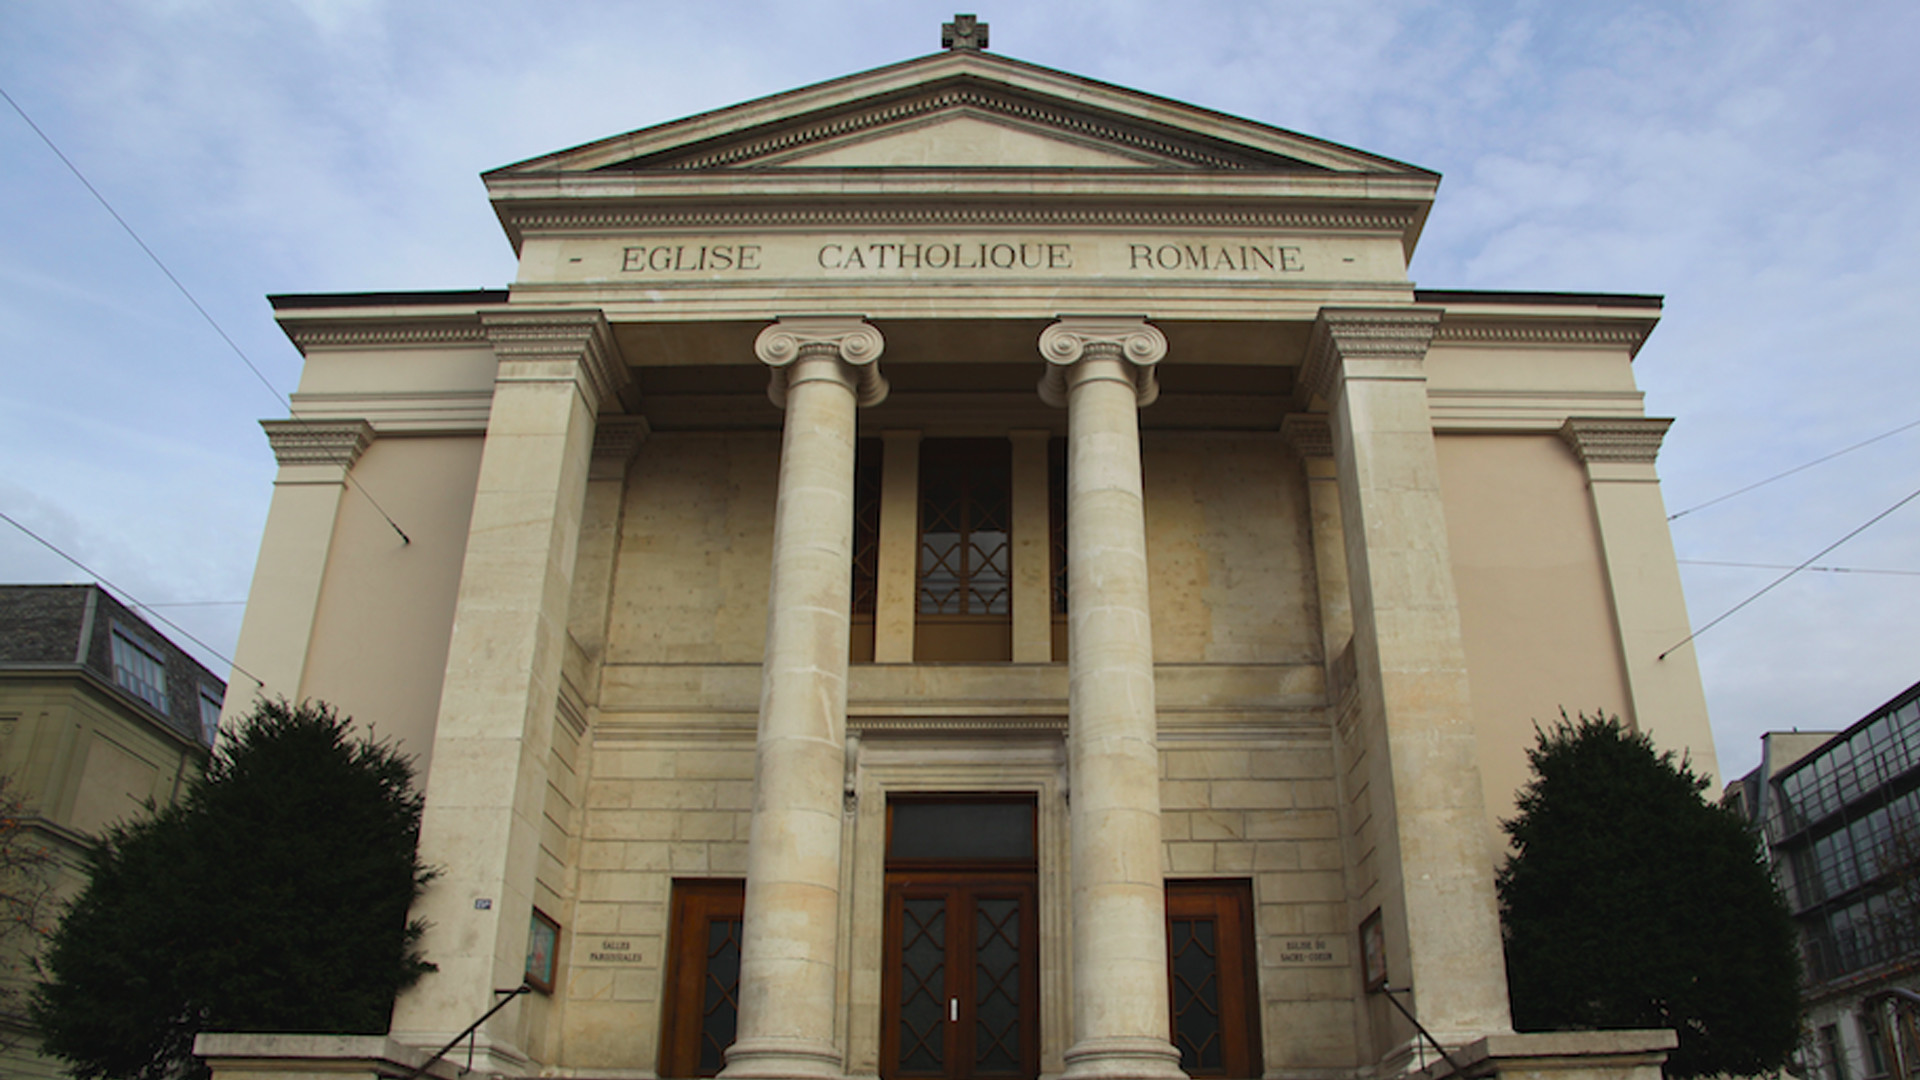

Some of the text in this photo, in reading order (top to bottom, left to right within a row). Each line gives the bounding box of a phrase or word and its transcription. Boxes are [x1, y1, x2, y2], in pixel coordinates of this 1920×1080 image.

[620, 243, 1306, 273] EGLISE CATHOLIQUE ROMAINE
